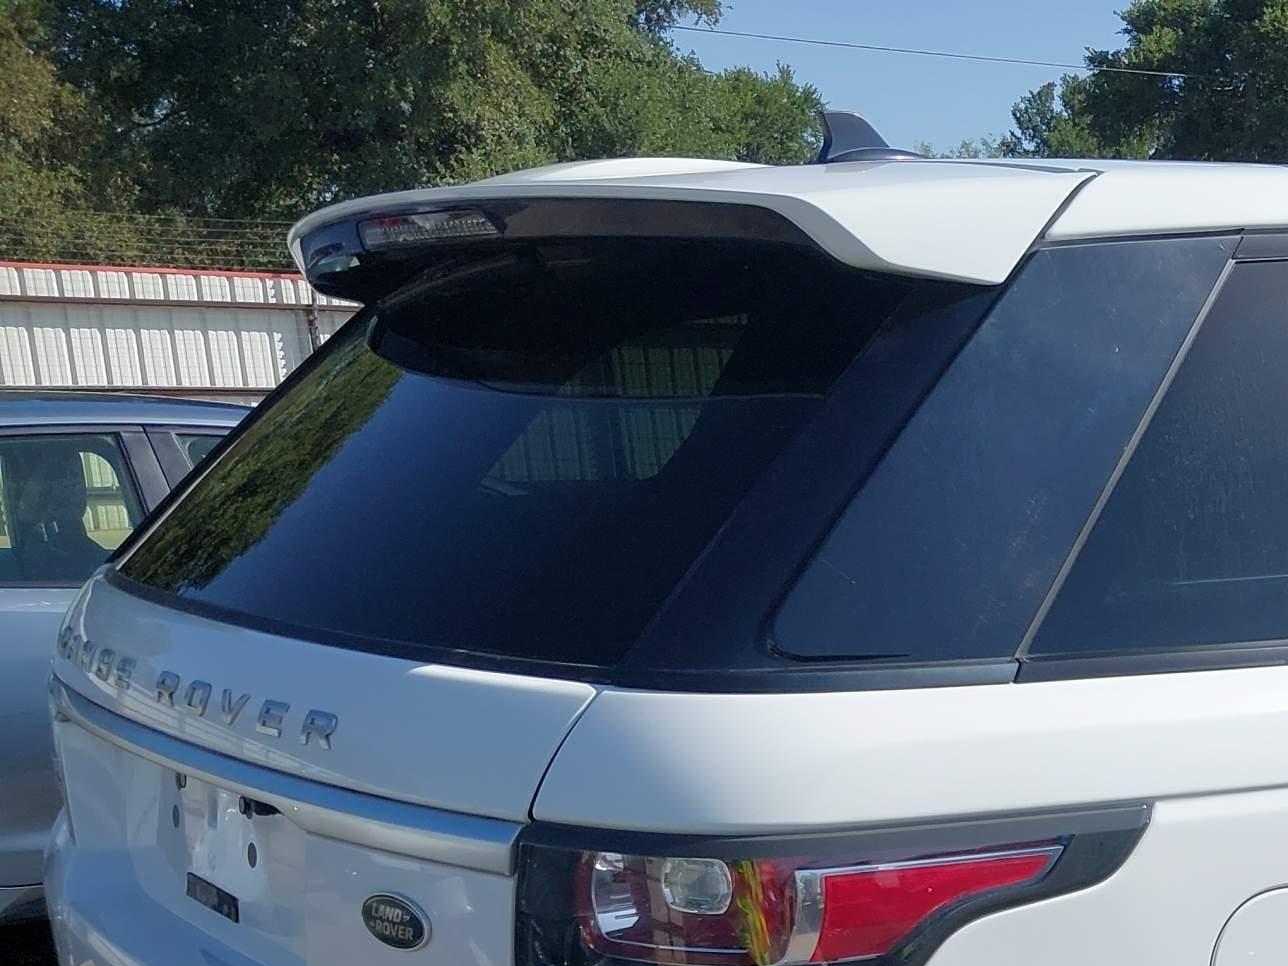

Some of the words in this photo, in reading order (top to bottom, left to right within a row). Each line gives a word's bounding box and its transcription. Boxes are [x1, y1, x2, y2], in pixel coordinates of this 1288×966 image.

[156, 670, 339, 750] ROVER
[371, 902, 402, 923] LAND
[375, 919, 414, 941] ROVER
